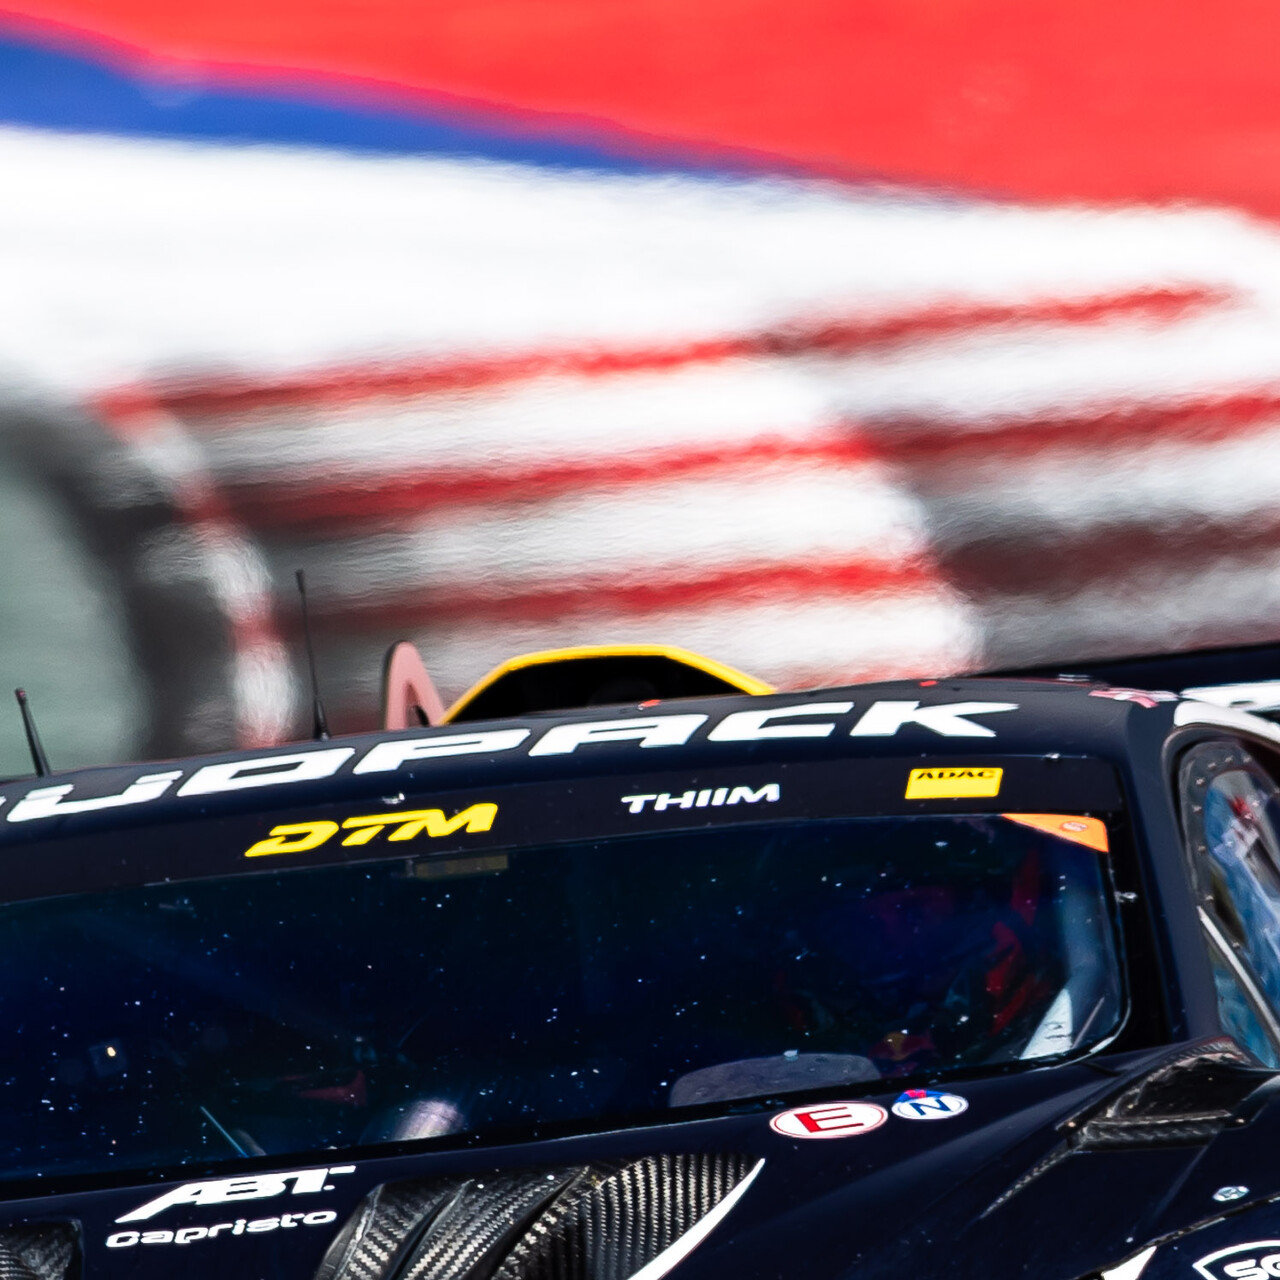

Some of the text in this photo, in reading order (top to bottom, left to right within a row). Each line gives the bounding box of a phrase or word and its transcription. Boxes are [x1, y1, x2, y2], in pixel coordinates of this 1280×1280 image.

[621, 784, 780, 813] THIIM
[245, 803, 498, 857] DTM
[115, 1165, 356, 1223] ABT
